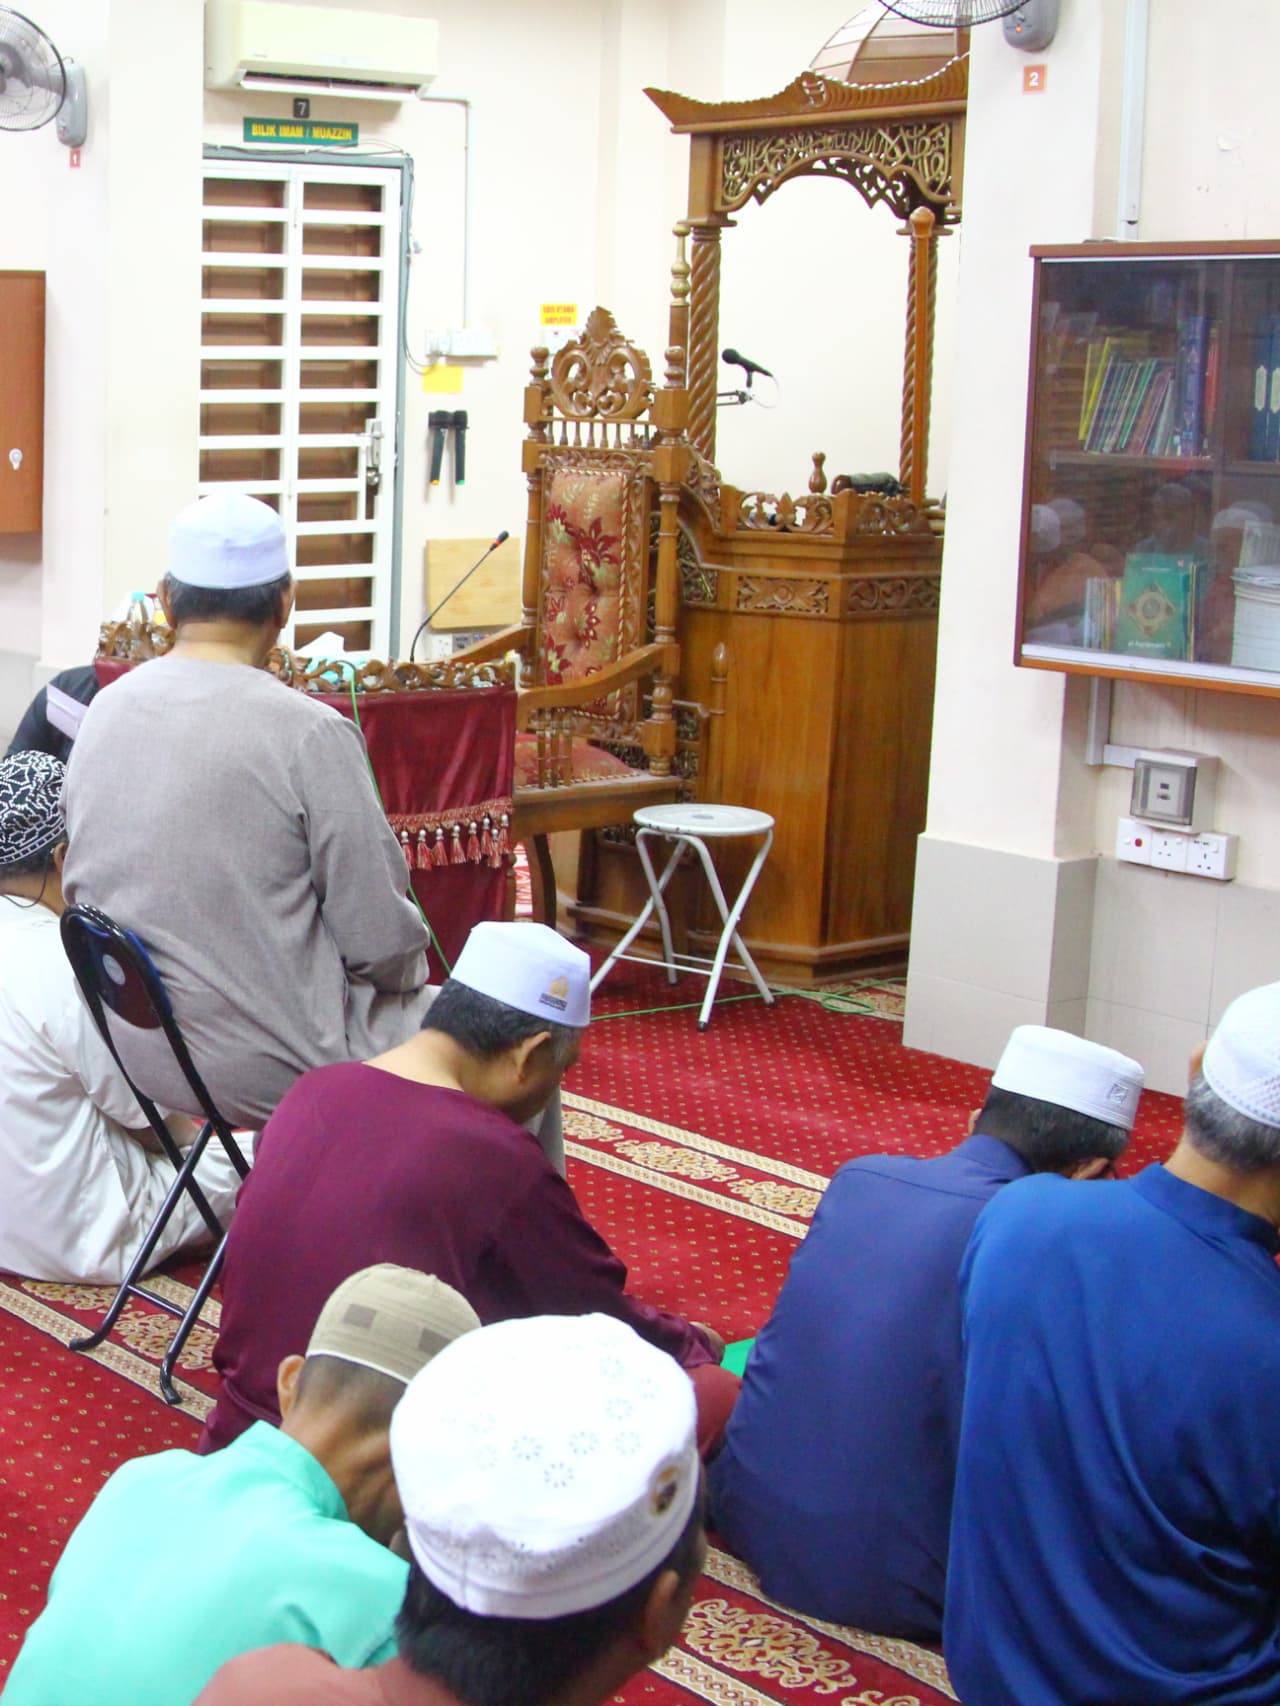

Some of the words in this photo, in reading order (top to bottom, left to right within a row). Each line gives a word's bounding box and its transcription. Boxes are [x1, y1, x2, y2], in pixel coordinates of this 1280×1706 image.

[1029, 71, 1039, 87] 2
[297, 101, 307, 116] 7
[251, 123, 277, 137] BILIK
[280, 125, 304, 138] IMAM
[312, 126, 353, 140] MUAZZIN
